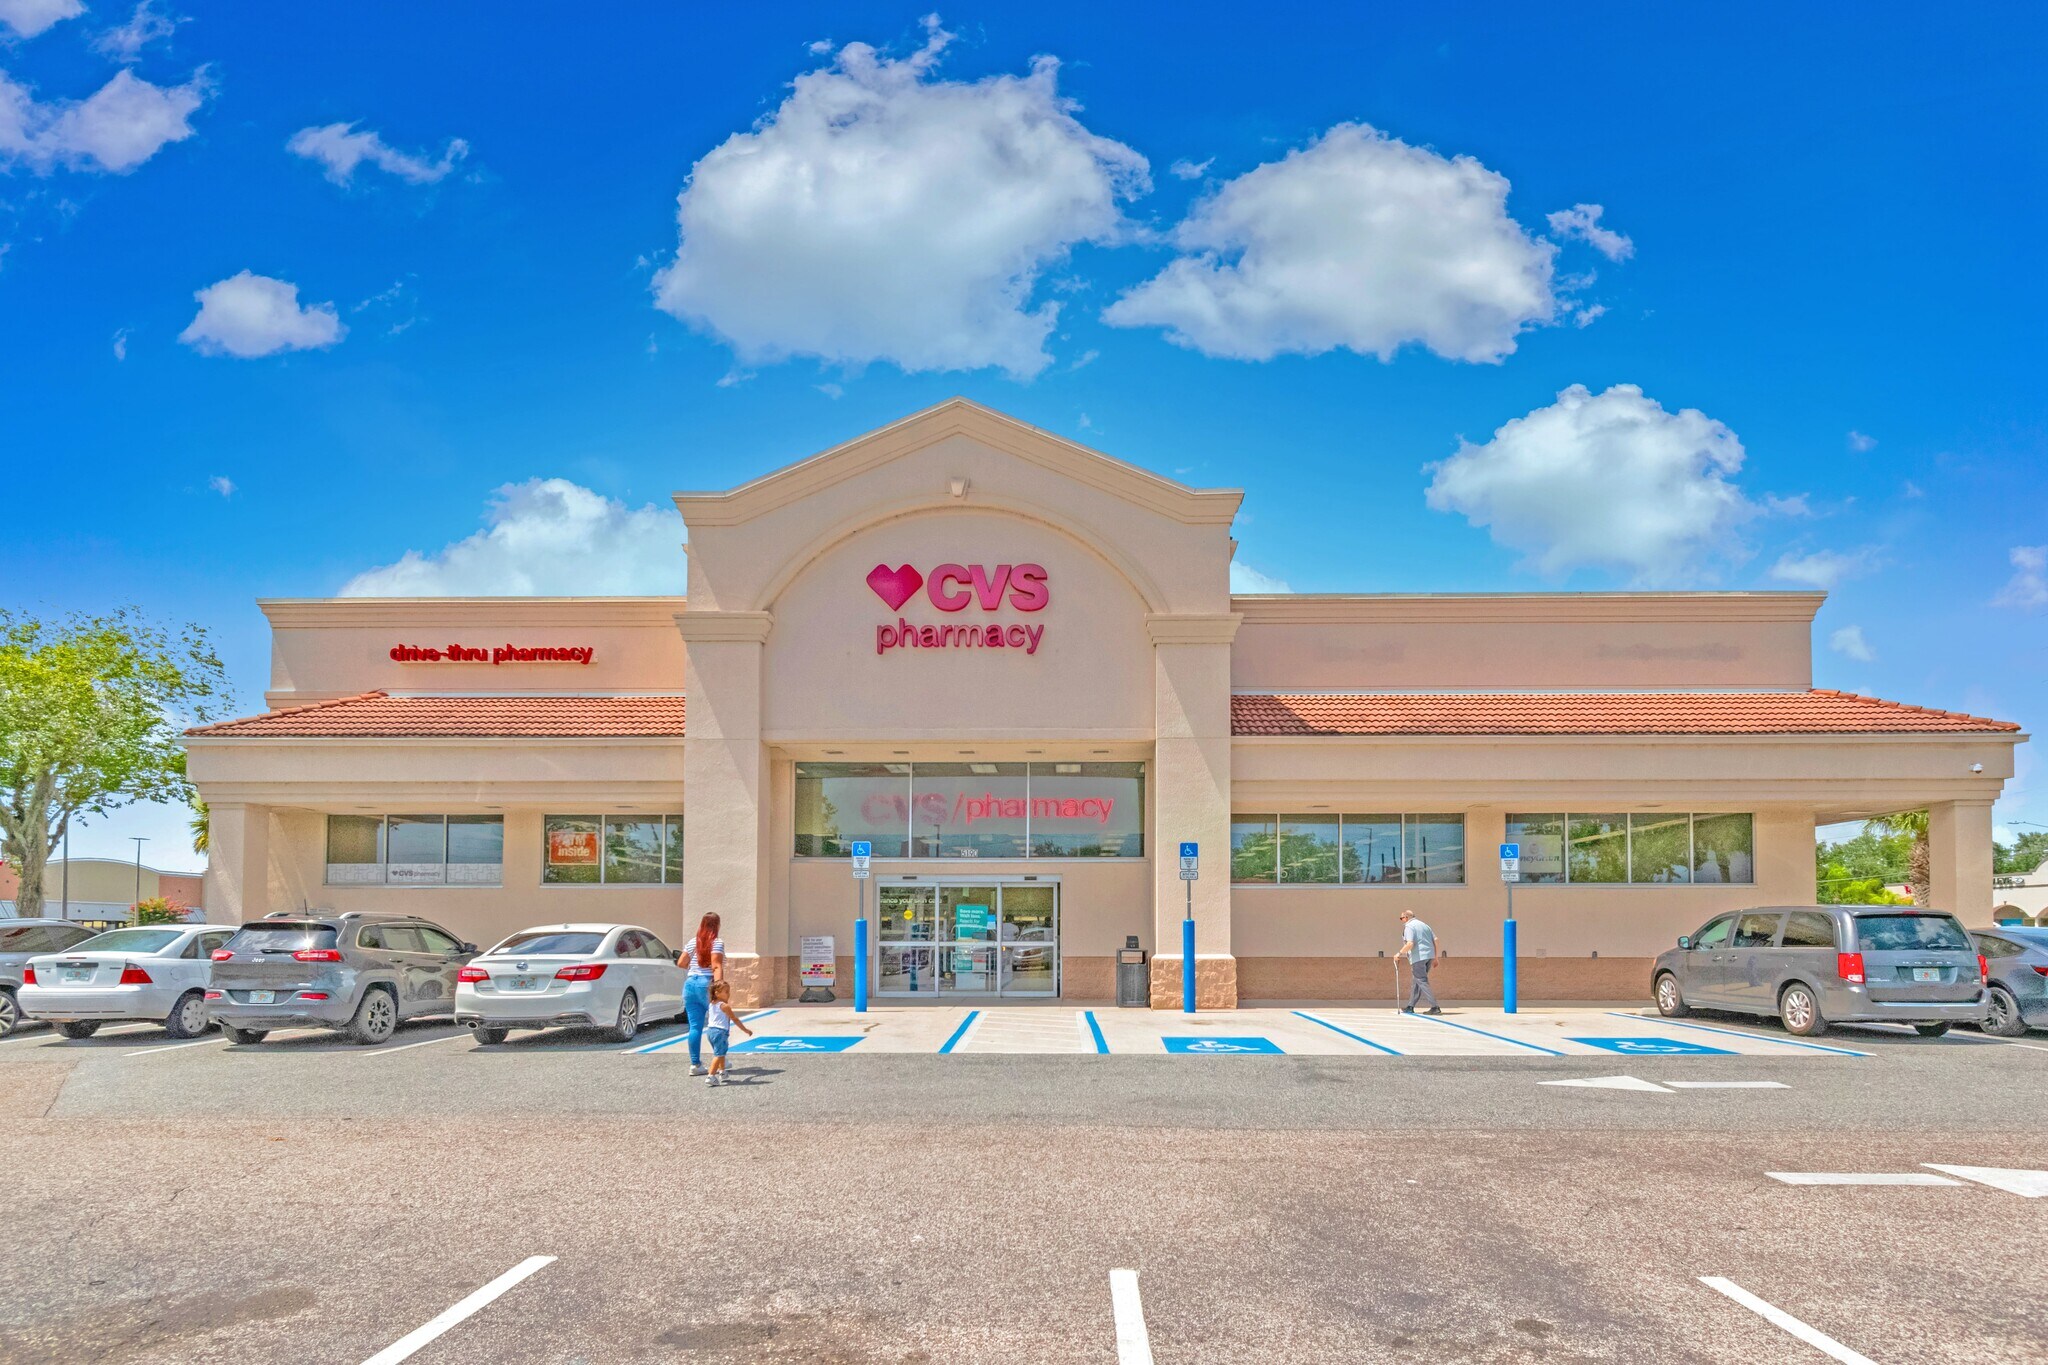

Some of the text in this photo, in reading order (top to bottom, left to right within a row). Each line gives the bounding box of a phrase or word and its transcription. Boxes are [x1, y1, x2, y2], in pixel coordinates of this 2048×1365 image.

[927, 563, 1049, 612] CVS
[876, 617, 1044, 655] pharmacy
[390, 643, 594, 665] drive-thru pharmacy
[557, 845, 590, 857] inside
